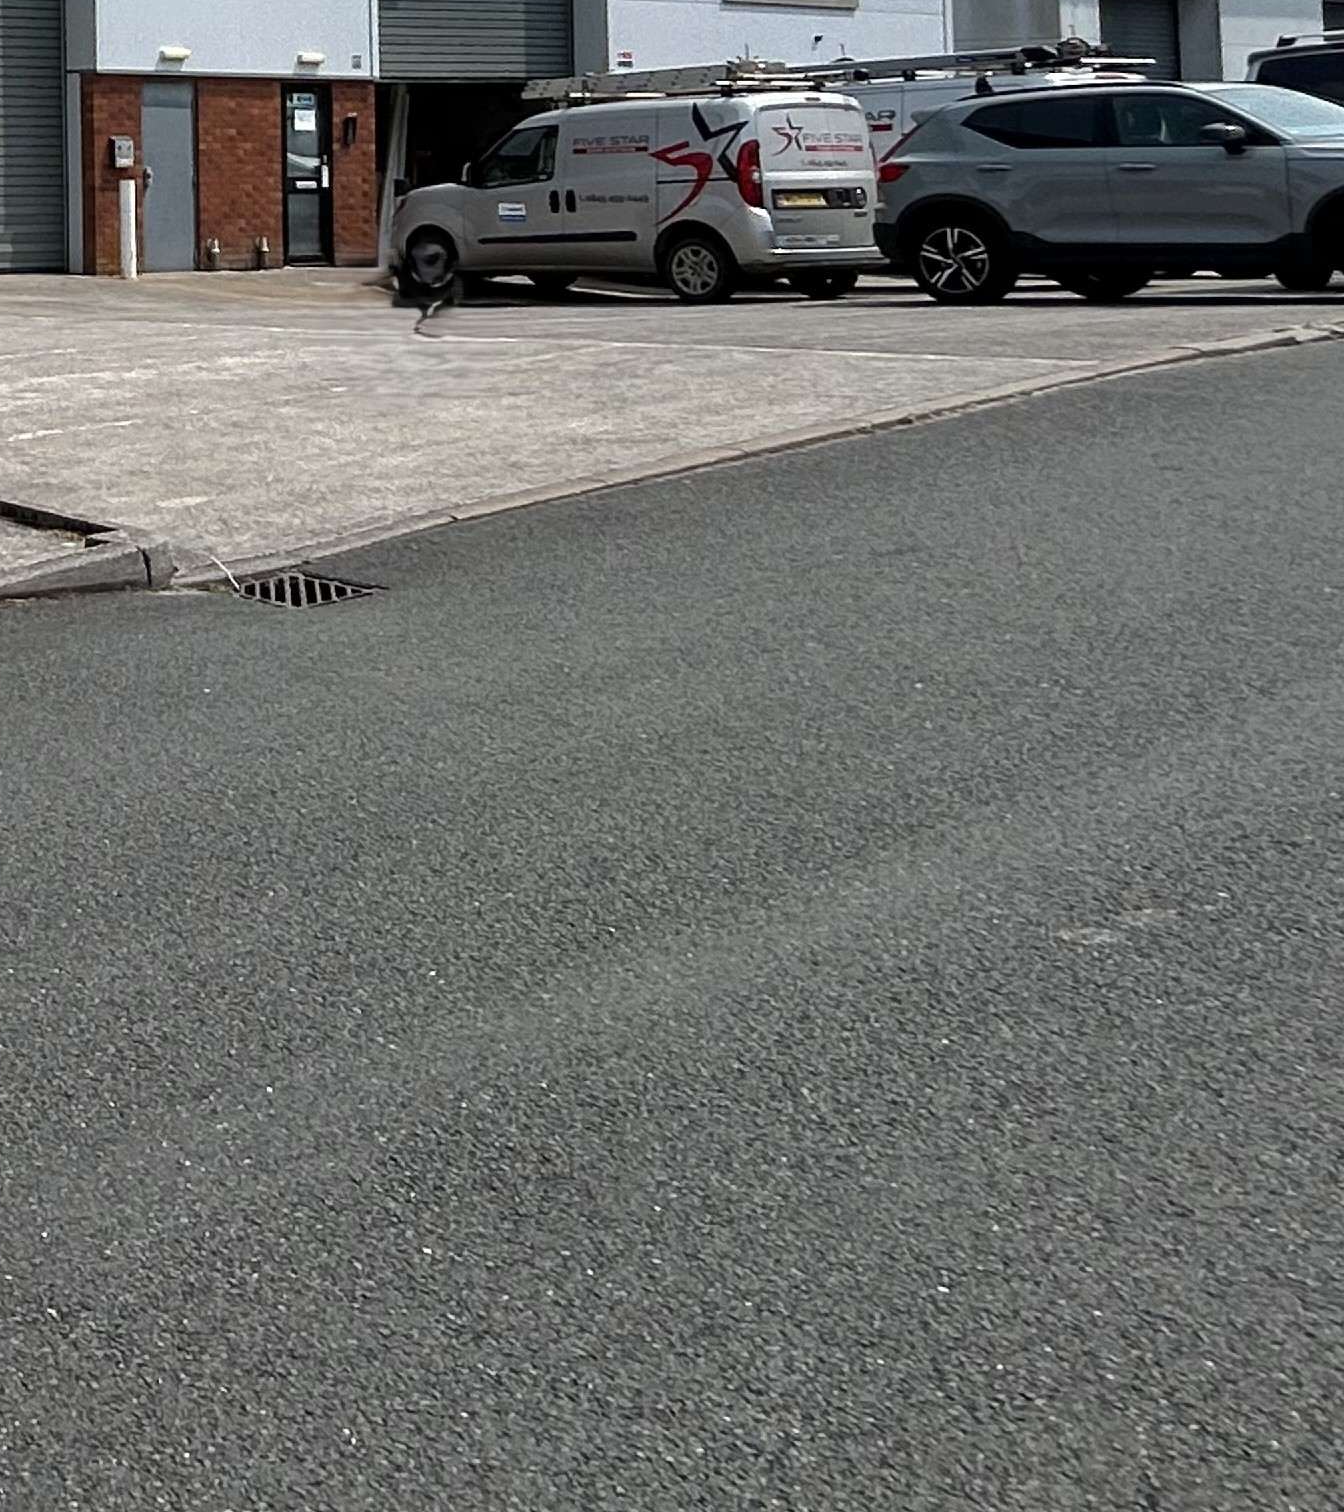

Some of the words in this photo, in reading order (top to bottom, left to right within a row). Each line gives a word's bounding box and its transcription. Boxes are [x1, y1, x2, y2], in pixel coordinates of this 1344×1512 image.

[865, 110, 896, 121] AR
[573, 137, 605, 146] FIVE
[610, 134, 649, 145] STAR
[802, 133, 831, 143] FIVE
[835, 133, 862, 143] STAR
